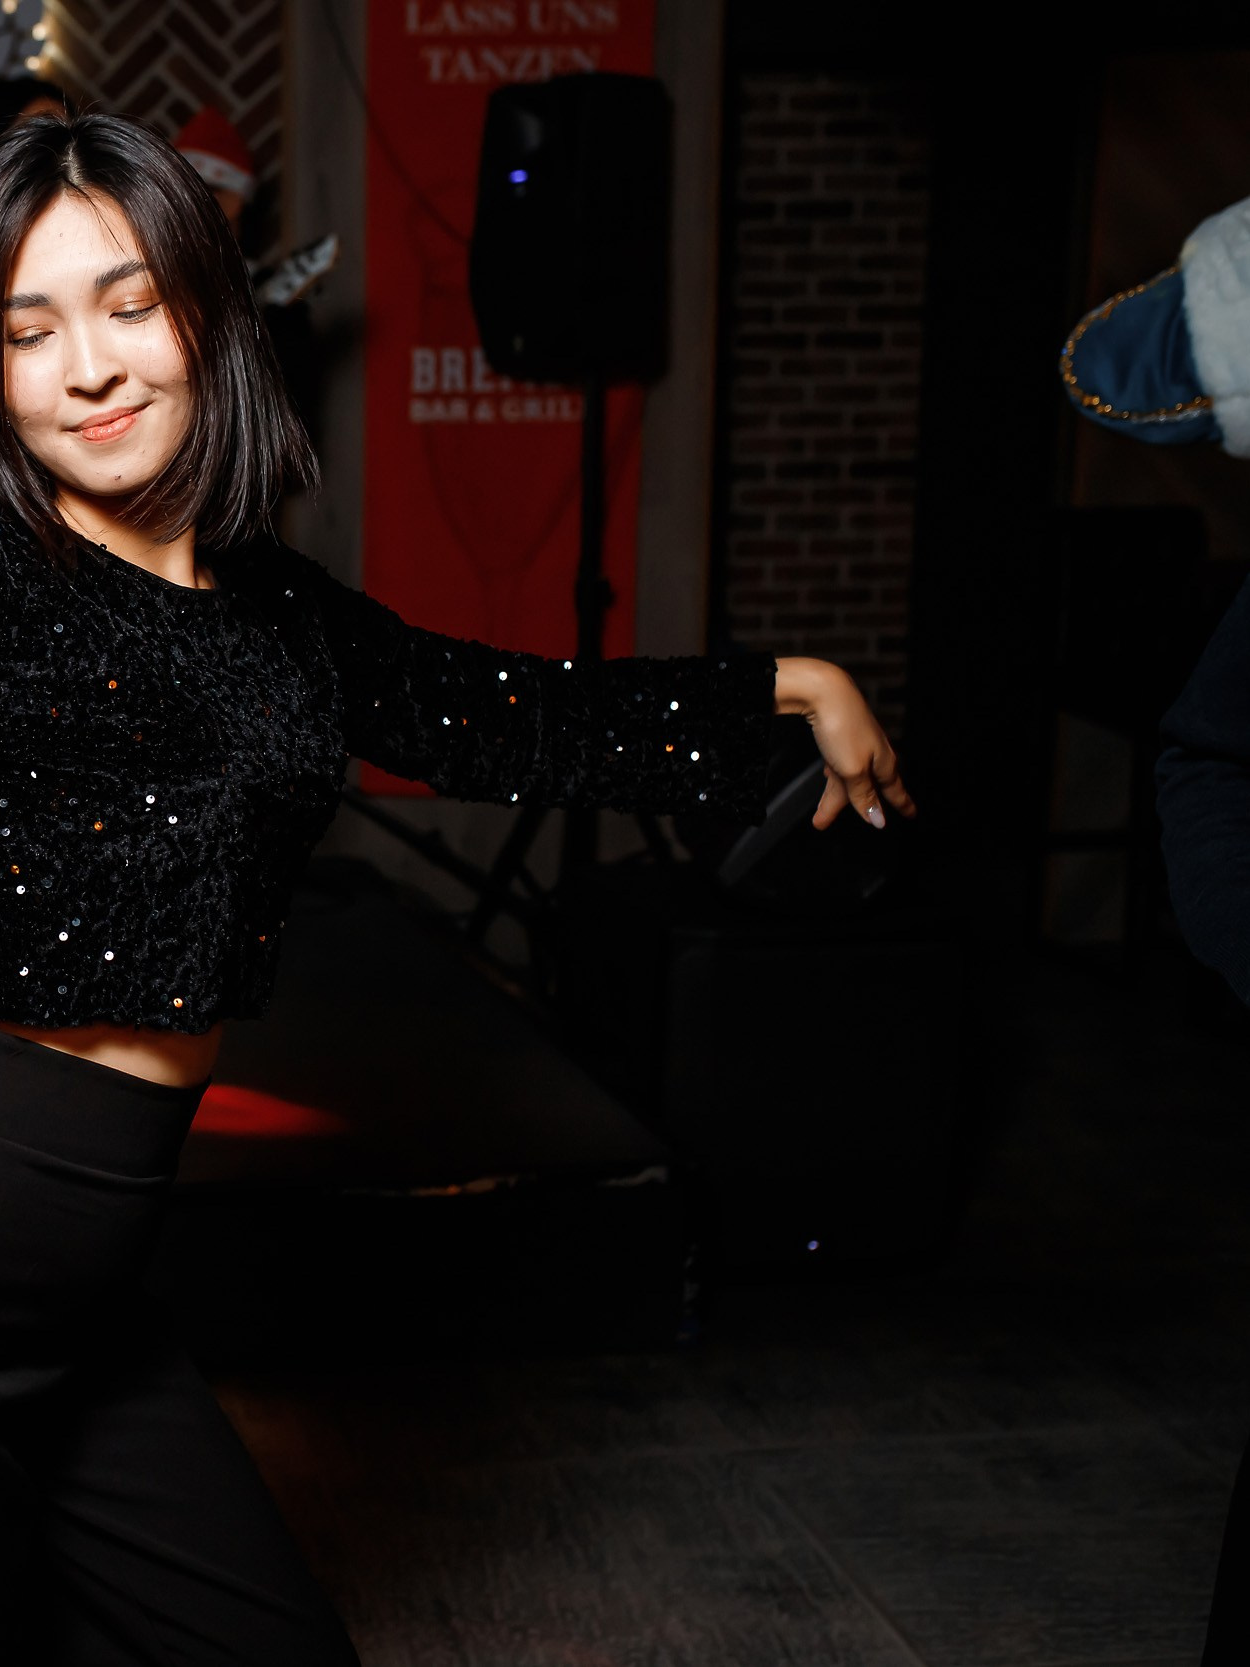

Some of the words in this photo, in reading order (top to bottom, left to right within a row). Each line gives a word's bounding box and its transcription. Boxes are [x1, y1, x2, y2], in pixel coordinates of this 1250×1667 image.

[406, 0, 516, 34] LASS
[529, 0, 619, 34] UNS
[410, 398, 469, 423] BAR
[474, 399, 494, 423] &
